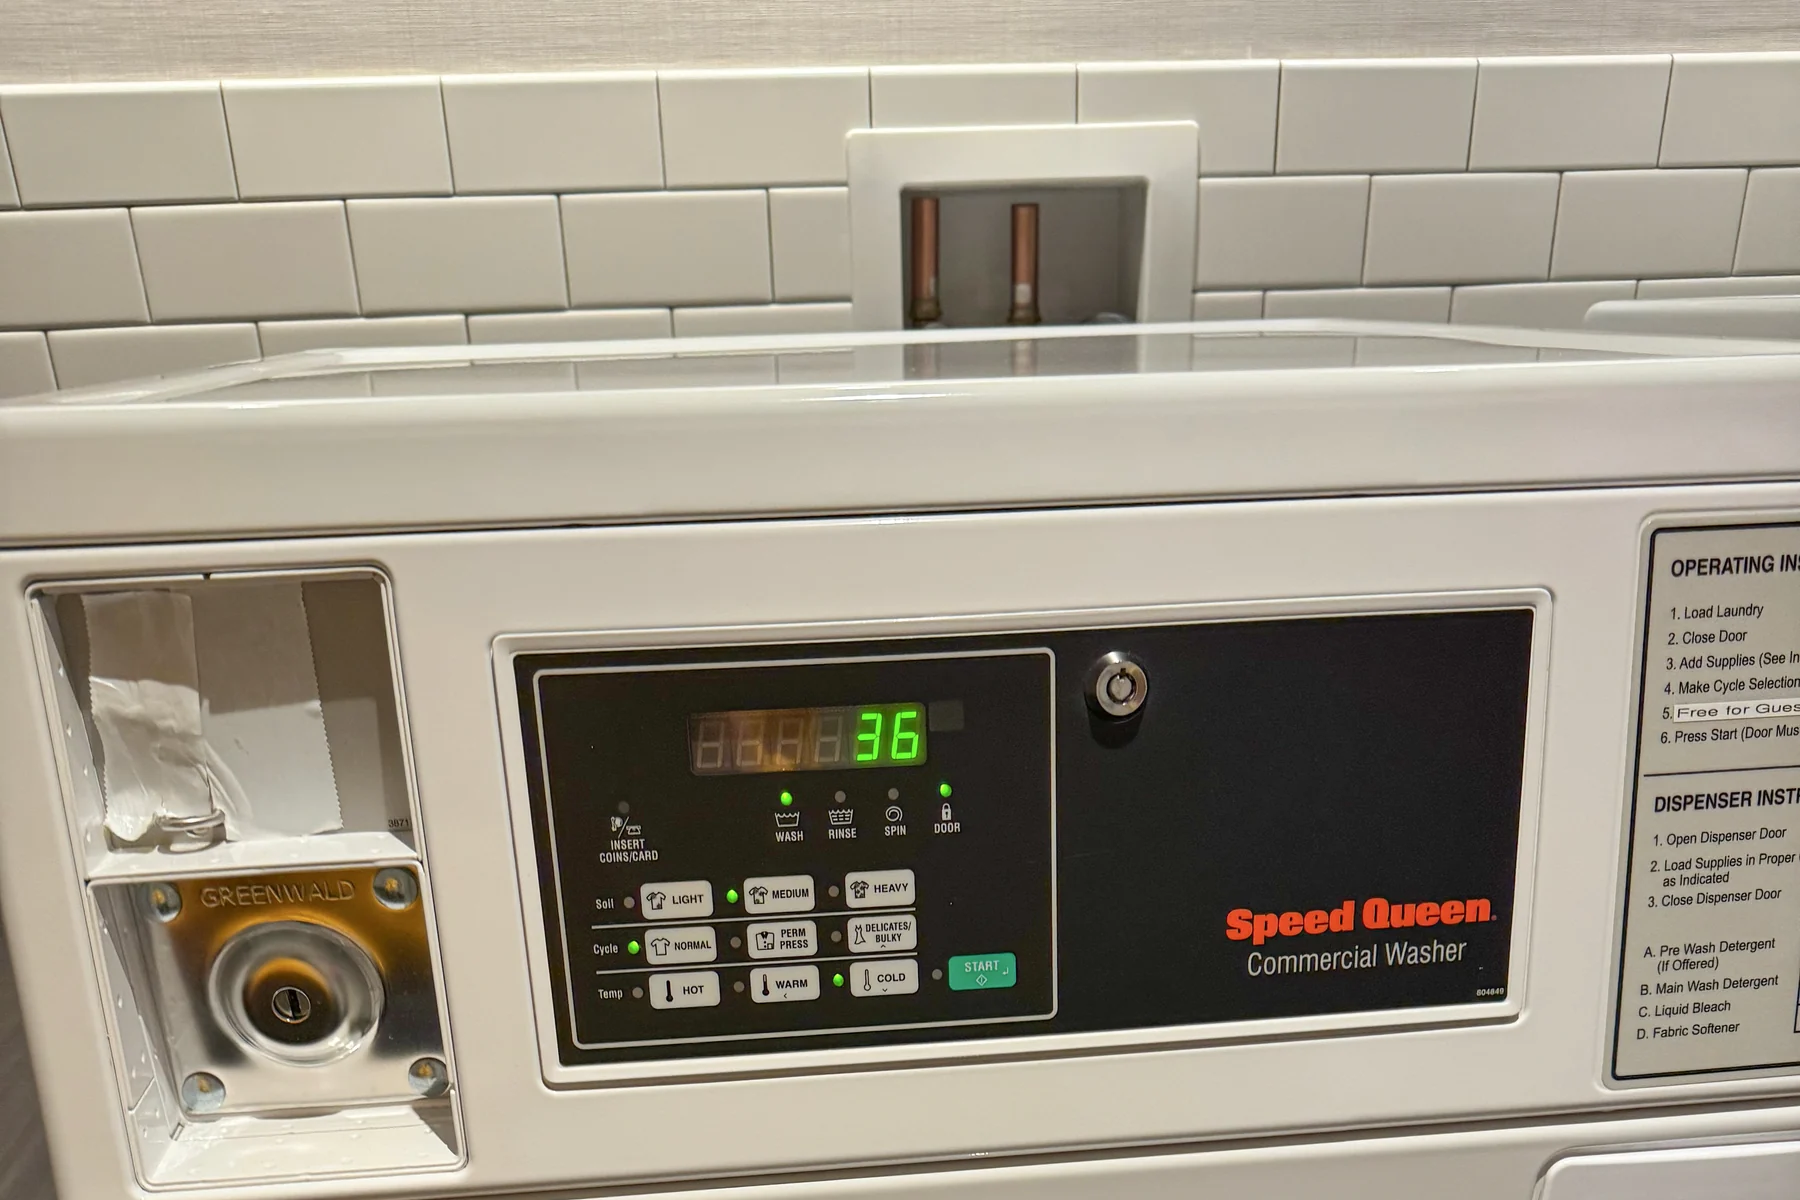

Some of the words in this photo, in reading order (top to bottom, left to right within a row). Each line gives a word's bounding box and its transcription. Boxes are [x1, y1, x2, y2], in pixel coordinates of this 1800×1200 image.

[1671, 555, 1774, 577] OPERATING
[1671, 608, 1680, 620] 1.
[1684, 606, 1713, 619] Load
[1717, 604, 1764, 619] Laundry
[1668, 633, 1678, 645] 2.
[1682, 631, 1715, 645] Close
[1720, 630, 1747, 642] Door
[1666, 658, 1676, 670] 3.
[1680, 656, 1702, 669] Add
[1707, 653, 1755, 670] Supplies
[1759, 652, 1786, 668] (See
[1665, 683, 1674, 695] 4.
[1679, 680, 1710, 694] Make
[1714, 679, 1745, 695] Cycle
[1663, 707, 1673, 719] 5.
[1677, 707, 1718, 718] Free
[1726, 705, 1750, 716] for
[856, 712, 919, 761] 36
[1661, 732, 1670, 744] 6.
[1675, 731, 1707, 743] Press
[1711, 727, 1738, 741] Start
[1741, 725, 1772, 742] (Door
[1654, 791, 1752, 812] DISPENSER
[828, 828, 857, 840] RINSE
[884, 825, 906, 836] SPIN
[934, 822, 960, 834] DOOR
[776, 830, 804, 842] WASH
[1653, 834, 1663, 846] 1.
[1667, 833, 1696, 848] Open
[1701, 830, 1756, 845] Dispenser
[1759, 828, 1787, 840] Door
[611, 839, 645, 850] INSERT
[599, 850, 658, 863] COINS/CARD
[1650, 860, 1660, 872] 2.
[1664, 858, 1692, 871] Load
[1696, 855, 1742, 871] Supplies
[1746, 854, 1755, 866] in
[1759, 854, 1795, 869] Proper
[1663, 877, 1676, 887] as
[1679, 872, 1729, 886] Indicated
[201, 881, 355, 907] GREENWALD
[772, 888, 809, 899] MEDIUM
[874, 883, 909, 893] HEAVY
[596, 899, 614, 909] Soil
[672, 895, 704, 905] LIGHT
[1648, 896, 1658, 908] 3.
[1662, 894, 1693, 906] Close
[1696, 891, 1751, 906] Dispenser
[1755, 889, 1782, 900] Door
[865, 921, 911, 932] DELICATES/
[1226, 900, 1355, 945] Speed
[1362, 898, 1491, 929] Queen
[781, 928, 806, 938] PERM
[875, 933, 902, 943] BULKY
[593, 944, 618, 955] Cycle
[674, 941, 711, 950] NORMAL
[780, 939, 808, 949] PRESS
[1644, 946, 1656, 958] A.
[1660, 945, 1679, 956] Pre
[1684, 942, 1715, 955] Wash
[1719, 938, 1775, 953] Detergent
[1247, 944, 1377, 976] Commercial
[1386, 940, 1467, 965] Washer
[964, 960, 999, 972] START
[1657, 960, 1670, 975] (If
[1673, 957, 1719, 972] Offered)
[776, 979, 808, 989] WARM
[877, 973, 906, 983] COLD
[683, 986, 704, 995] HOT
[1640, 984, 1652, 995] B.
[1656, 982, 1684, 995] Main
[1688, 979, 1719, 992] Wash
[1723, 975, 1778, 990] Detergent
[598, 989, 623, 1000] Temp
[1639, 1007, 1650, 1017] C.
[1655, 1003, 1688, 1018] Liquid
[1693, 1001, 1731, 1013] Bleach
[1637, 1029, 1648, 1040] D.
[1653, 1026, 1688, 1038] Fabric
[1692, 1023, 1740, 1035] Softener
